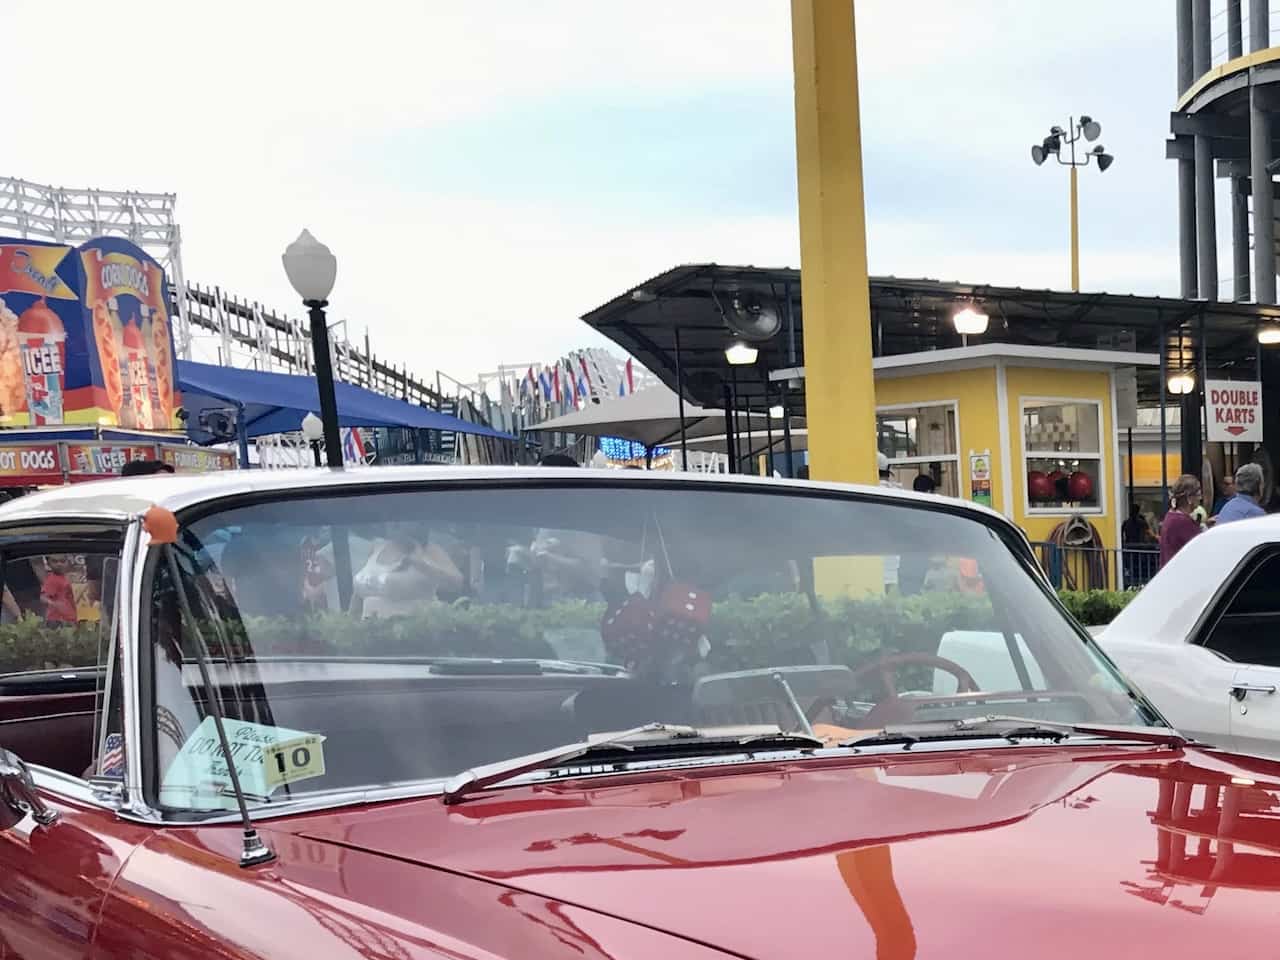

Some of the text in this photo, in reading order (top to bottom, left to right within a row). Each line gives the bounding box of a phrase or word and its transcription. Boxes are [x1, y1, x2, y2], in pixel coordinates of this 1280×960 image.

[24, 347, 62, 376] ICEE
[1211, 390, 1258, 406] DOUBLE
[1215, 407, 1255, 424] KARTS
[0, 451, 16, 470] OT
[21, 450, 55, 470] DOGS
[244, 744, 264, 764] TO
[274, 747, 311, 774] 10
